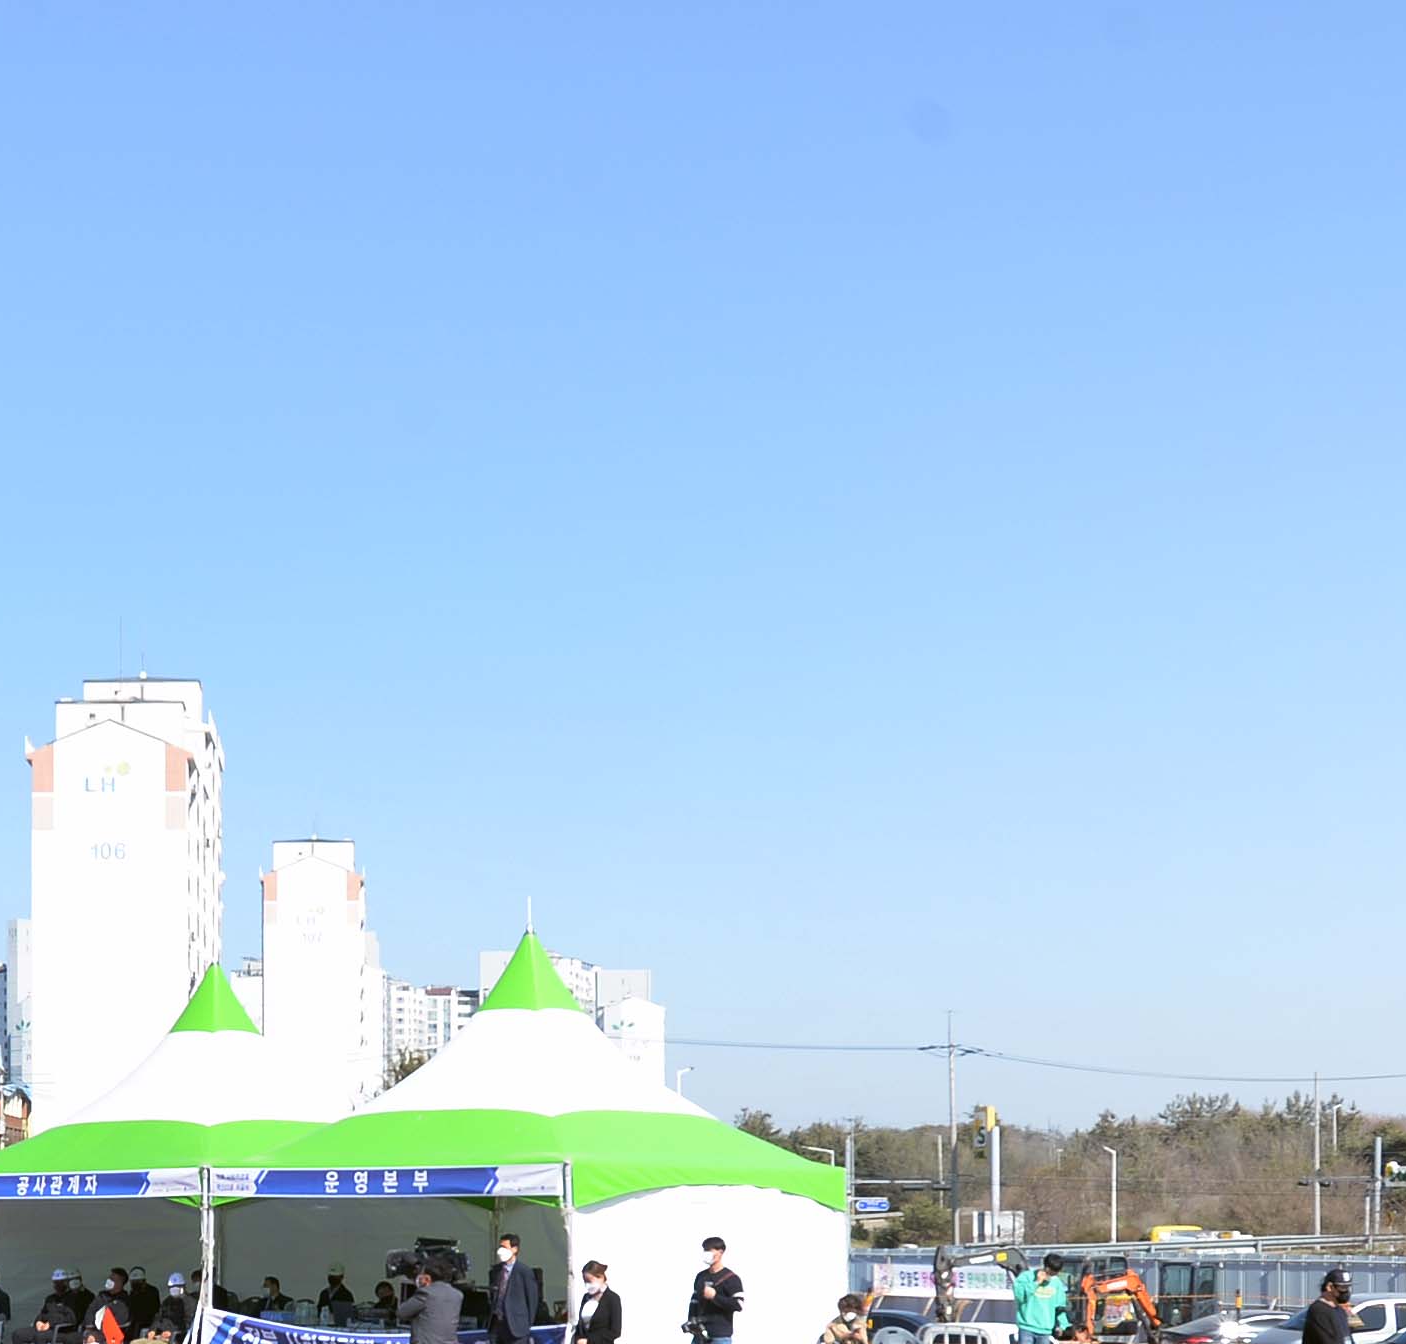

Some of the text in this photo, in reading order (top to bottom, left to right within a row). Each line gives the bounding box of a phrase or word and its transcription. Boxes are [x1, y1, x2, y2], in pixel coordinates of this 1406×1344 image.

[85, 776, 115, 792] LH
[91, 842, 125, 860] 106
[16, 1175, 98, 1196] 공사관계자
[324, 1170, 430, 1193] 운영본부
